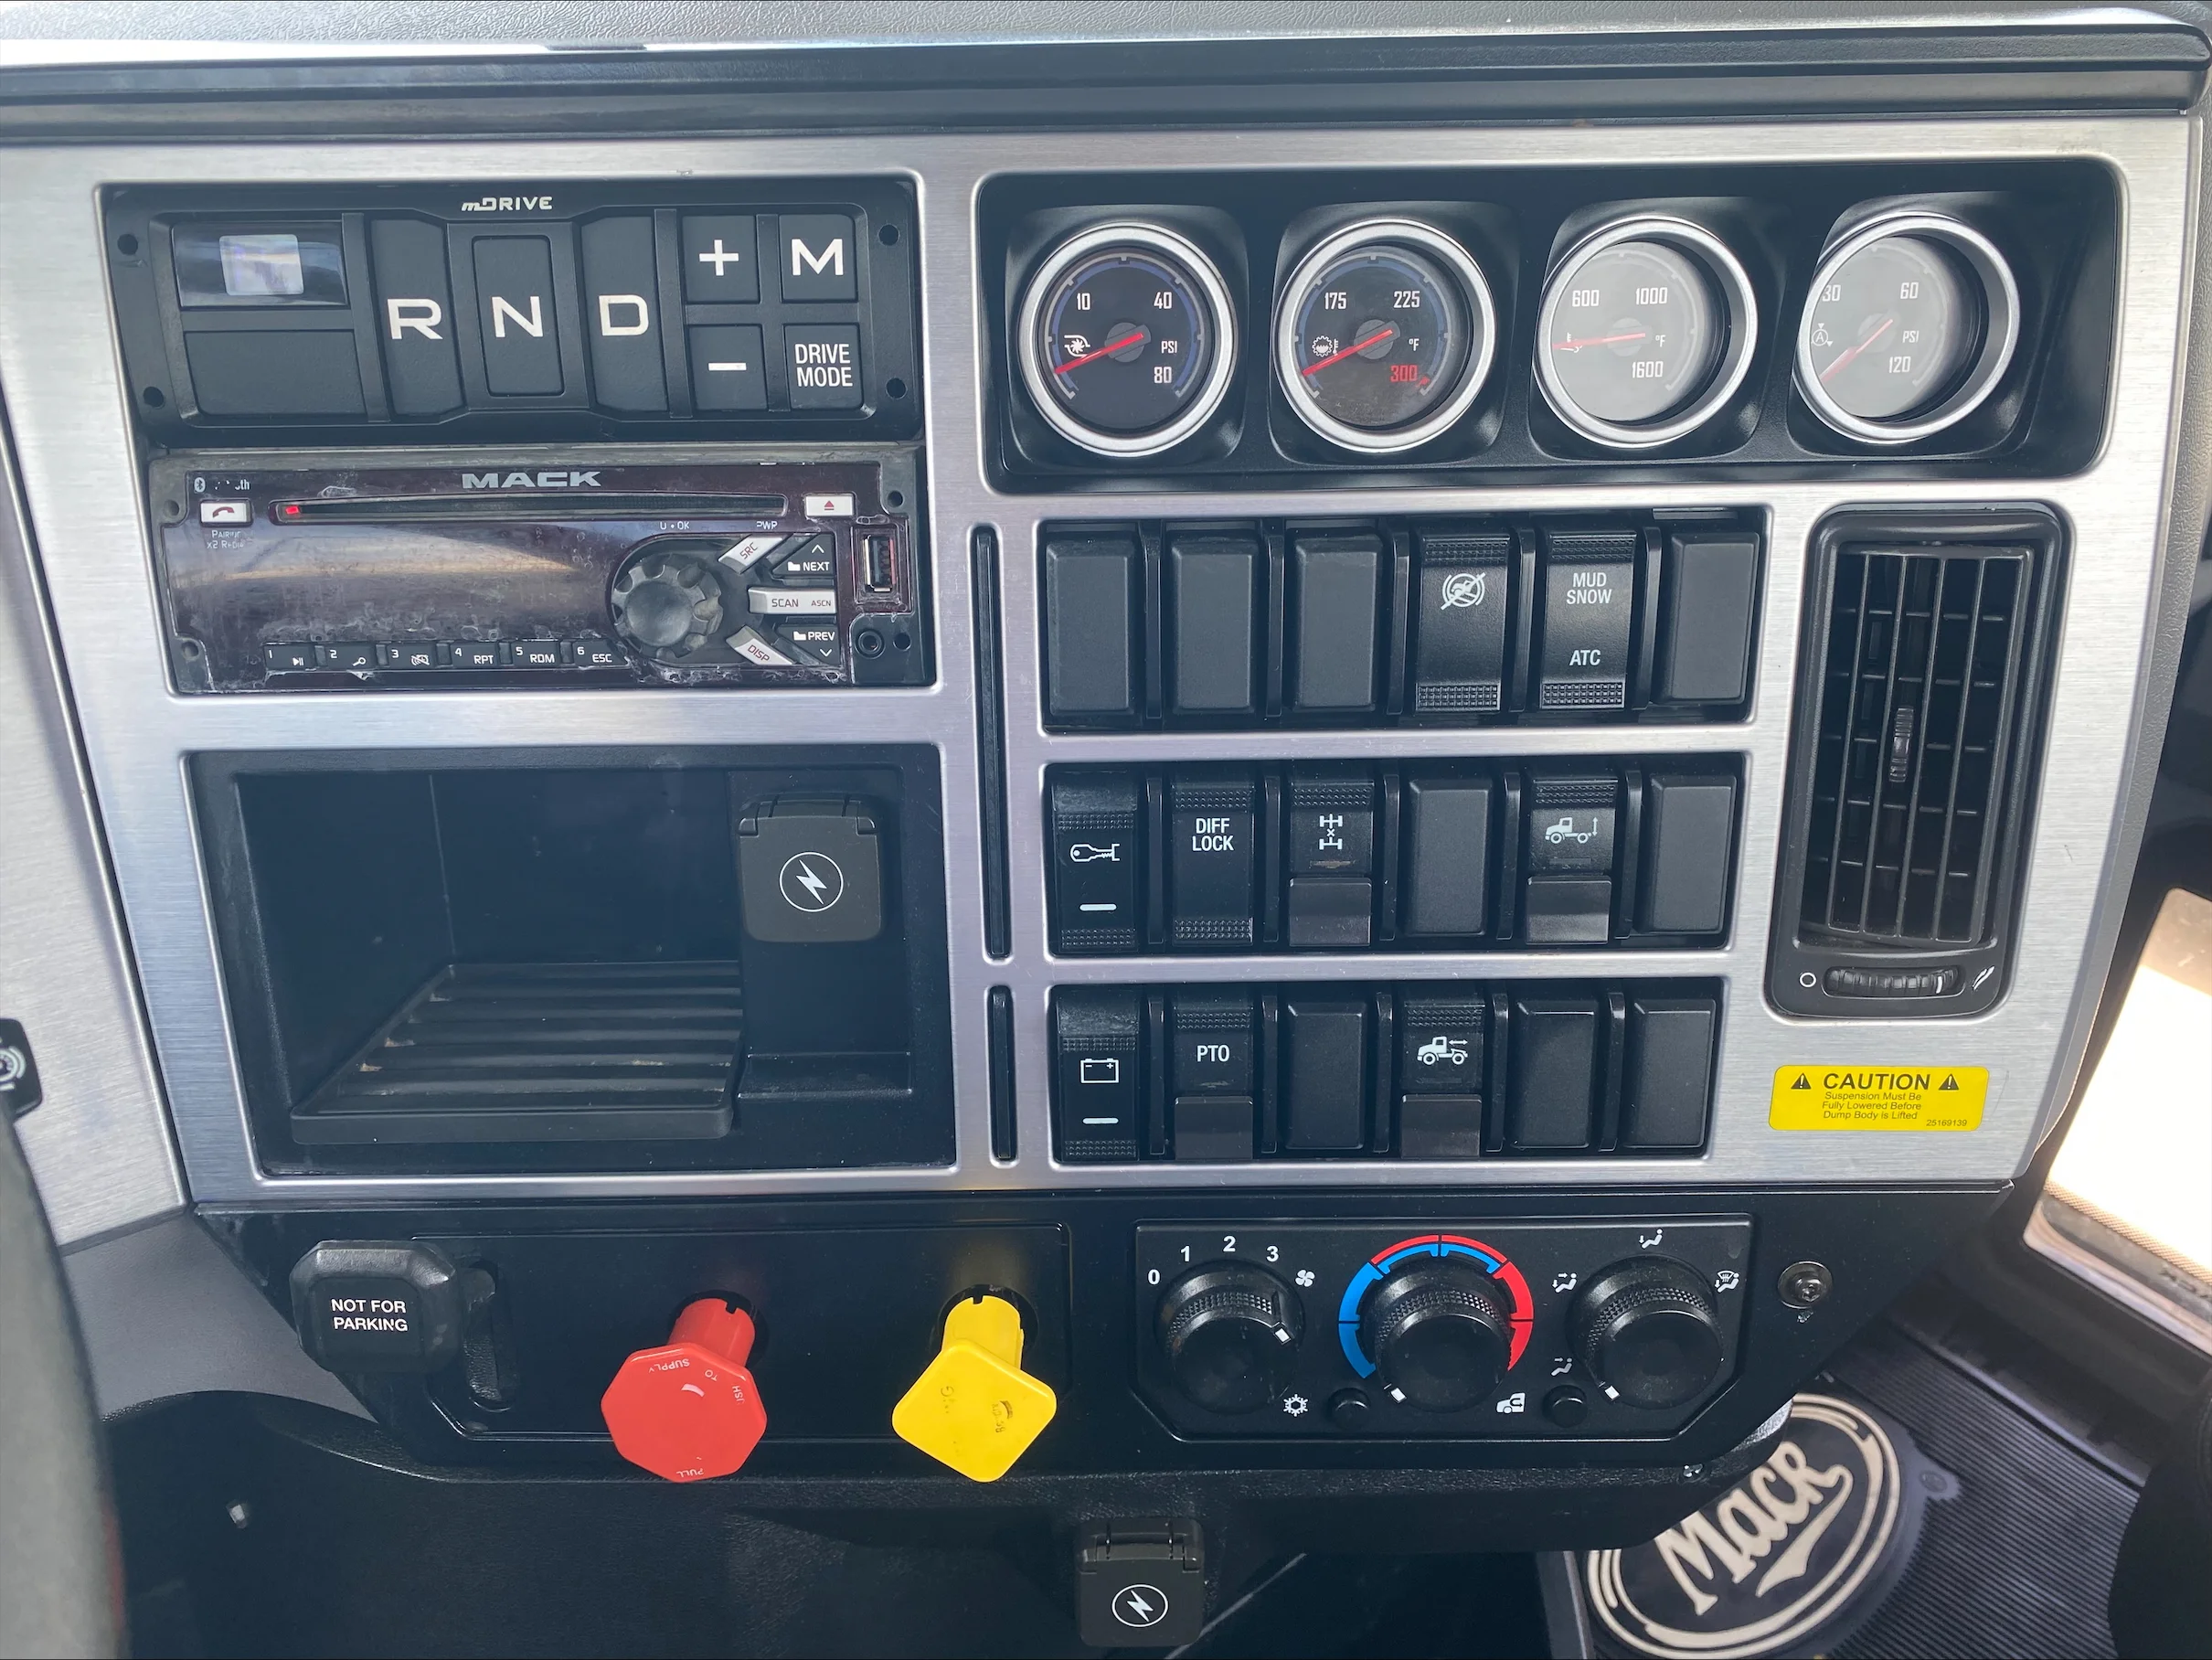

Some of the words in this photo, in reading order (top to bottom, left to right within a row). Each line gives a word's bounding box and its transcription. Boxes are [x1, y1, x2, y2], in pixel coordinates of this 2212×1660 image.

[462, 197, 552, 211] mDRIVE
[792, 239, 843, 275] M
[1636, 287, 1667, 304] 1000
[1822, 284, 1842, 302] 30
[1900, 282, 1919, 299] 60
[1077, 293, 1090, 310] 10
[1154, 293, 1172, 309] 40
[1325, 293, 1346, 309] 175
[1394, 291, 1420, 308] 225
[1572, 290, 1599, 307] 600
[388, 299, 442, 339] R
[492, 296, 543, 337] N
[599, 295, 648, 335] D
[1903, 331, 1919, 343] PSI
[794, 343, 851, 364] DRIVE
[1162, 341, 1177, 353] PSI
[1632, 361, 1663, 378] 1600
[1889, 356, 1910, 373] 120
[796, 367, 854, 388] MODE
[1154, 367, 1172, 383] 80
[1390, 365, 1418, 383] 300
[463, 472, 601, 488] MACK
[677, 521, 690, 530] OK
[739, 541, 758, 559] SRC
[803, 562, 829, 570] NEXT
[1573, 572, 1606, 587] MUD
[772, 599, 798, 607] SCAN
[1566, 589, 1612, 605] SNOW
[808, 632, 835, 640] PREV
[268, 649, 273, 659] 1
[329, 649, 338, 659] 2
[390, 649, 399, 658] 3
[454, 647, 463, 657] 4
[516, 646, 524, 657] 5
[577, 646, 585, 655] 6
[747, 644, 771, 662] DISP
[1569, 650, 1601, 666] ATC
[474, 655, 493, 664] RPT
[530, 654, 555, 663] RDM
[592, 654, 612, 663] ESC
[1196, 818, 1229, 834] DIFF
[1193, 835, 1234, 851] LOCK
[1197, 1045, 1229, 1061] PTO
[1824, 1073, 1930, 1090] CAUTION
[1824, 1091, 1880, 1101] Suspension
[1883, 1092, 1906, 1101] Must
[1909, 1092, 1922, 1101] Be
[1822, 1101, 1845, 1111] Fully
[1846, 1101, 1888, 1110] Lowered
[1890, 1101, 1922, 1110] Before
[1824, 1110, 1852, 1120] Dump
[1854, 1111, 1878, 1121] Body
[1891, 1111, 1918, 1119] Lifted
[1926, 1119, 1968, 1127] 25169139
[1223, 1236, 1235, 1251] 2
[1181, 1246, 1189, 1261] 1
[1267, 1246, 1279, 1261] 3
[1148, 1270, 1160, 1284] 0
[332, 1299, 366, 1312] NOT
[371, 1300, 406, 1313] FOR
[334, 1317, 408, 1331] PARKING
[704, 1369, 718, 1382] TO
[675, 1467, 705, 1478] PULL
[1654, 1441, 1854, 1616] Mack
